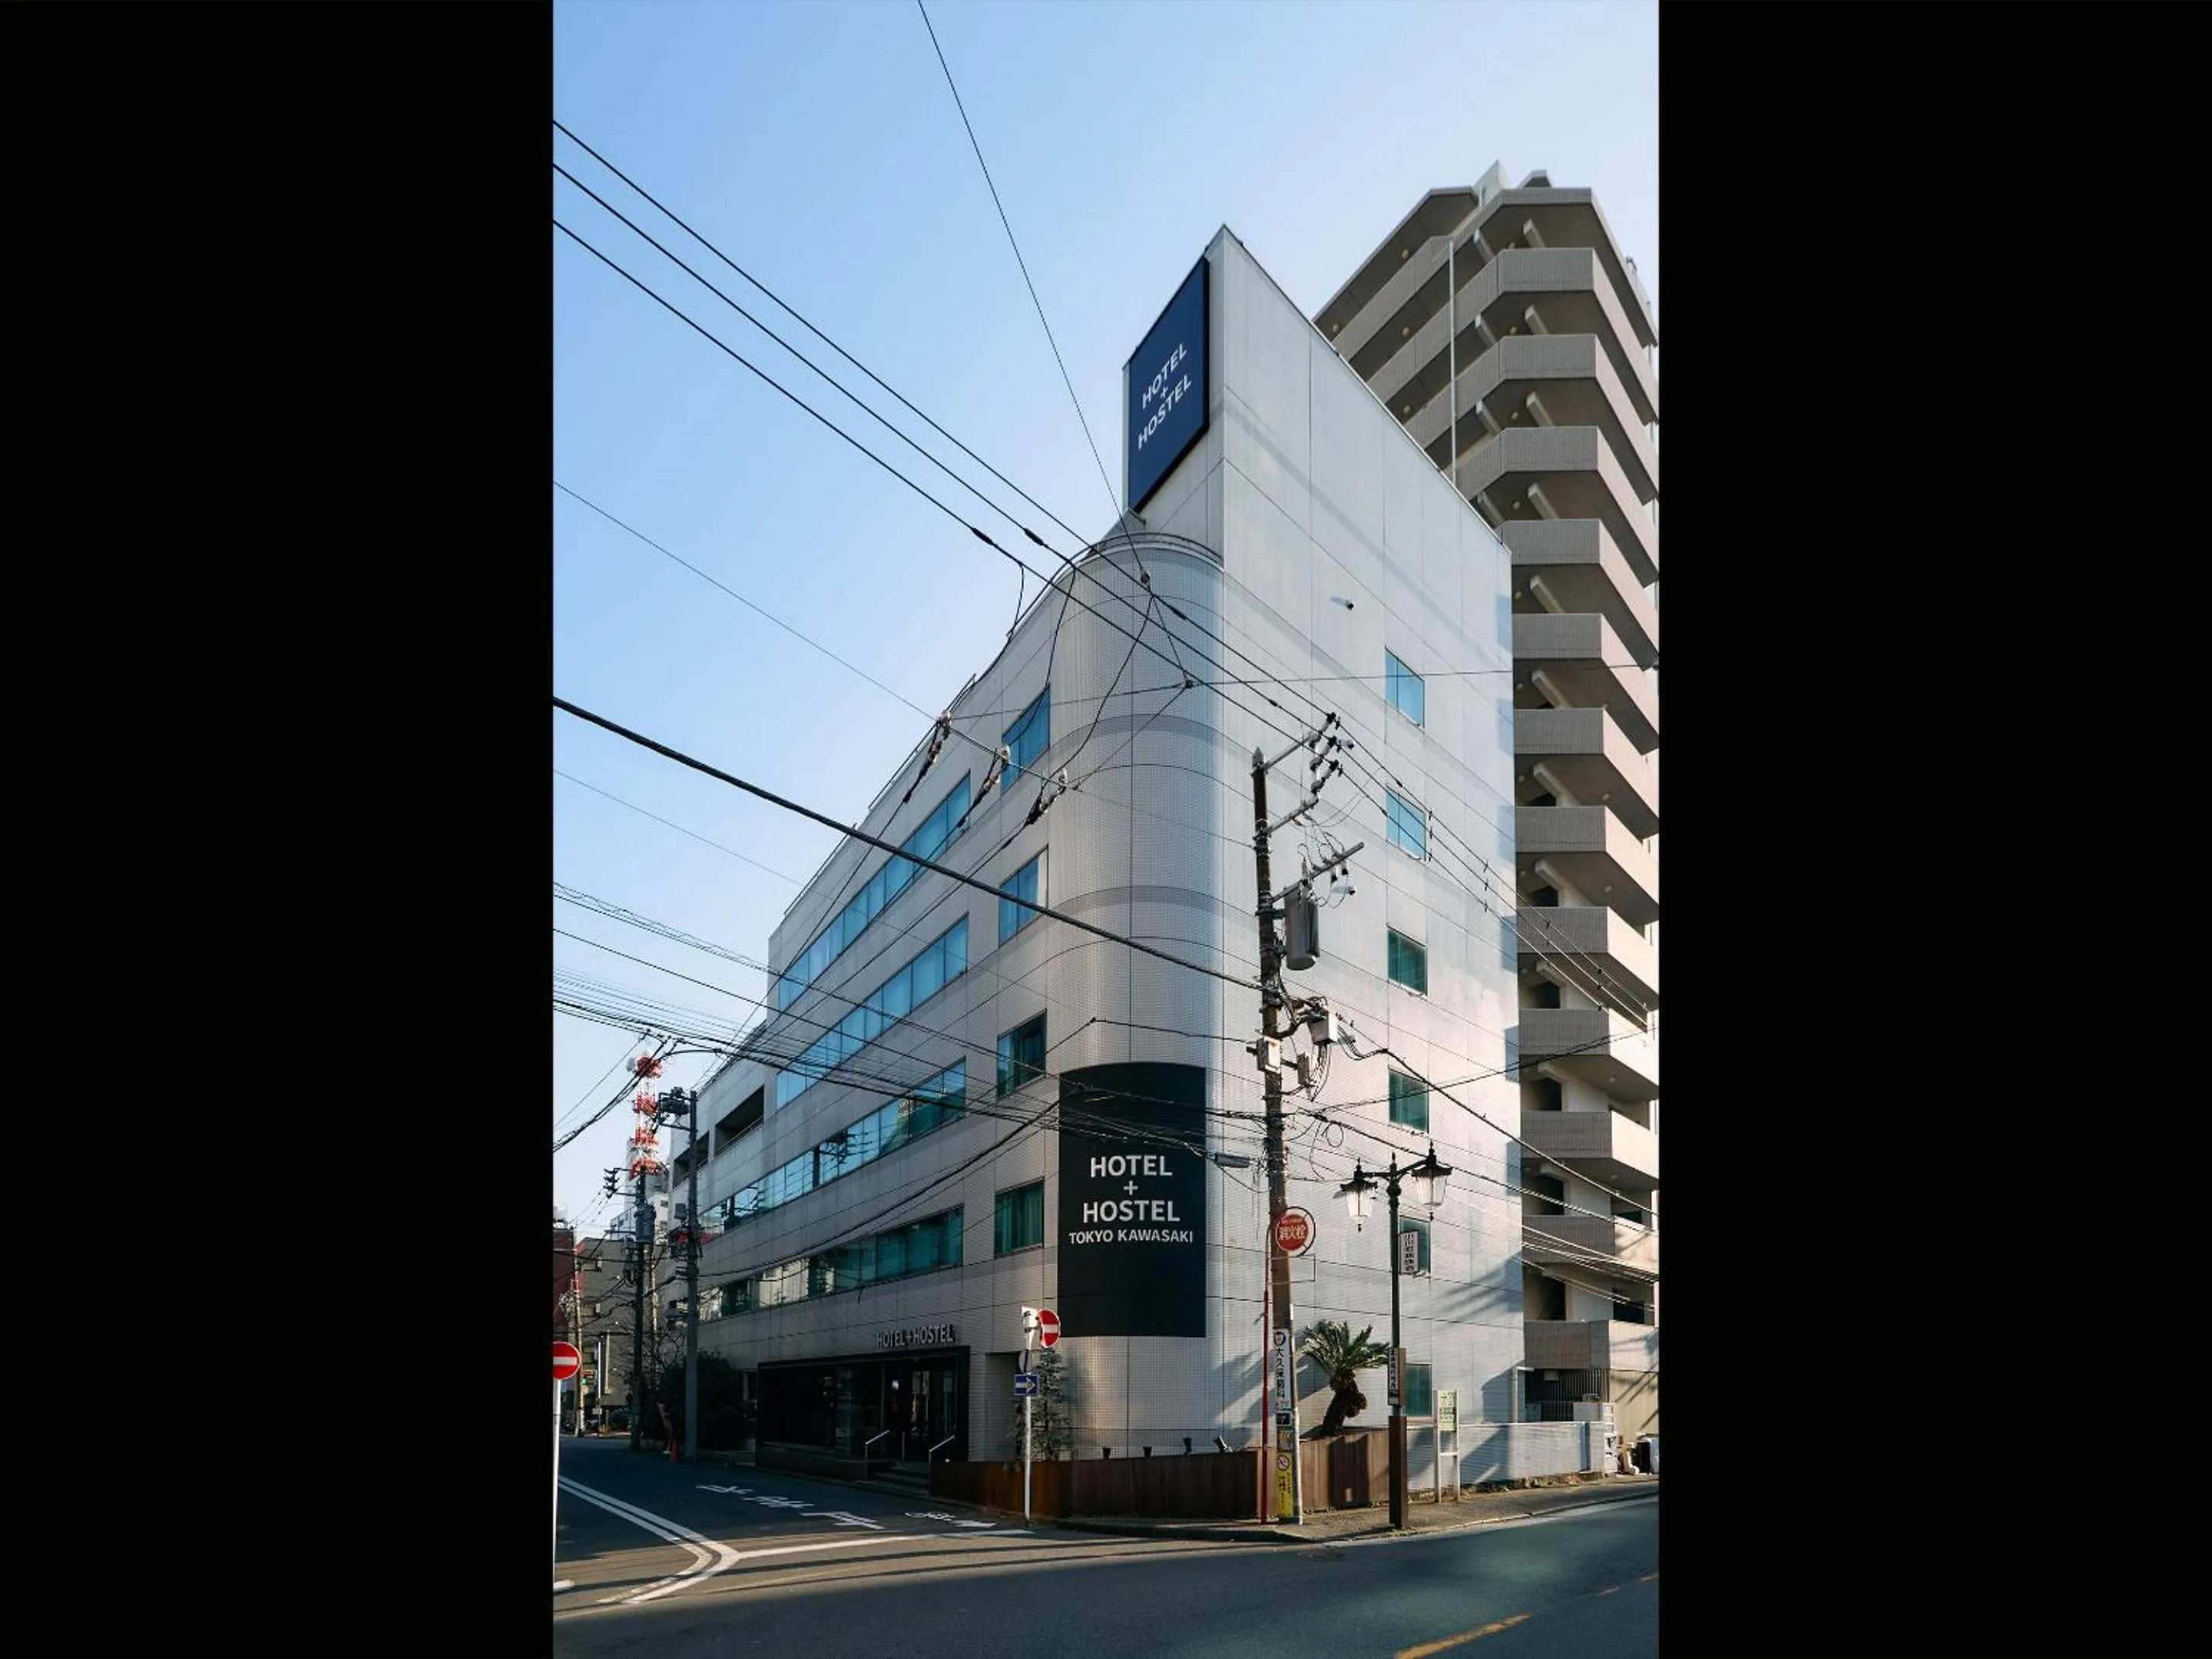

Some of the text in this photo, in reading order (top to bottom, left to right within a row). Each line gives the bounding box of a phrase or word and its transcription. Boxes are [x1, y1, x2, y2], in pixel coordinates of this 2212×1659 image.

[1141, 343, 1187, 410] HOTEL
[1137, 373, 1192, 451] HOSTEL
[1090, 1154, 1174, 1178] HOTEL
[1124, 1181, 1138, 1196] +
[1083, 1200, 1181, 1224] HOSTEL
[1068, 1229, 1193, 1244] TOKYO KAWASAKI
[1278, 1224, 1306, 1241] 消火栓
[877, 1329, 906, 1349] HOTEL
[913, 1323, 954, 1346] HOSTEL
[696, 1484, 886, 1530] 止まれ
